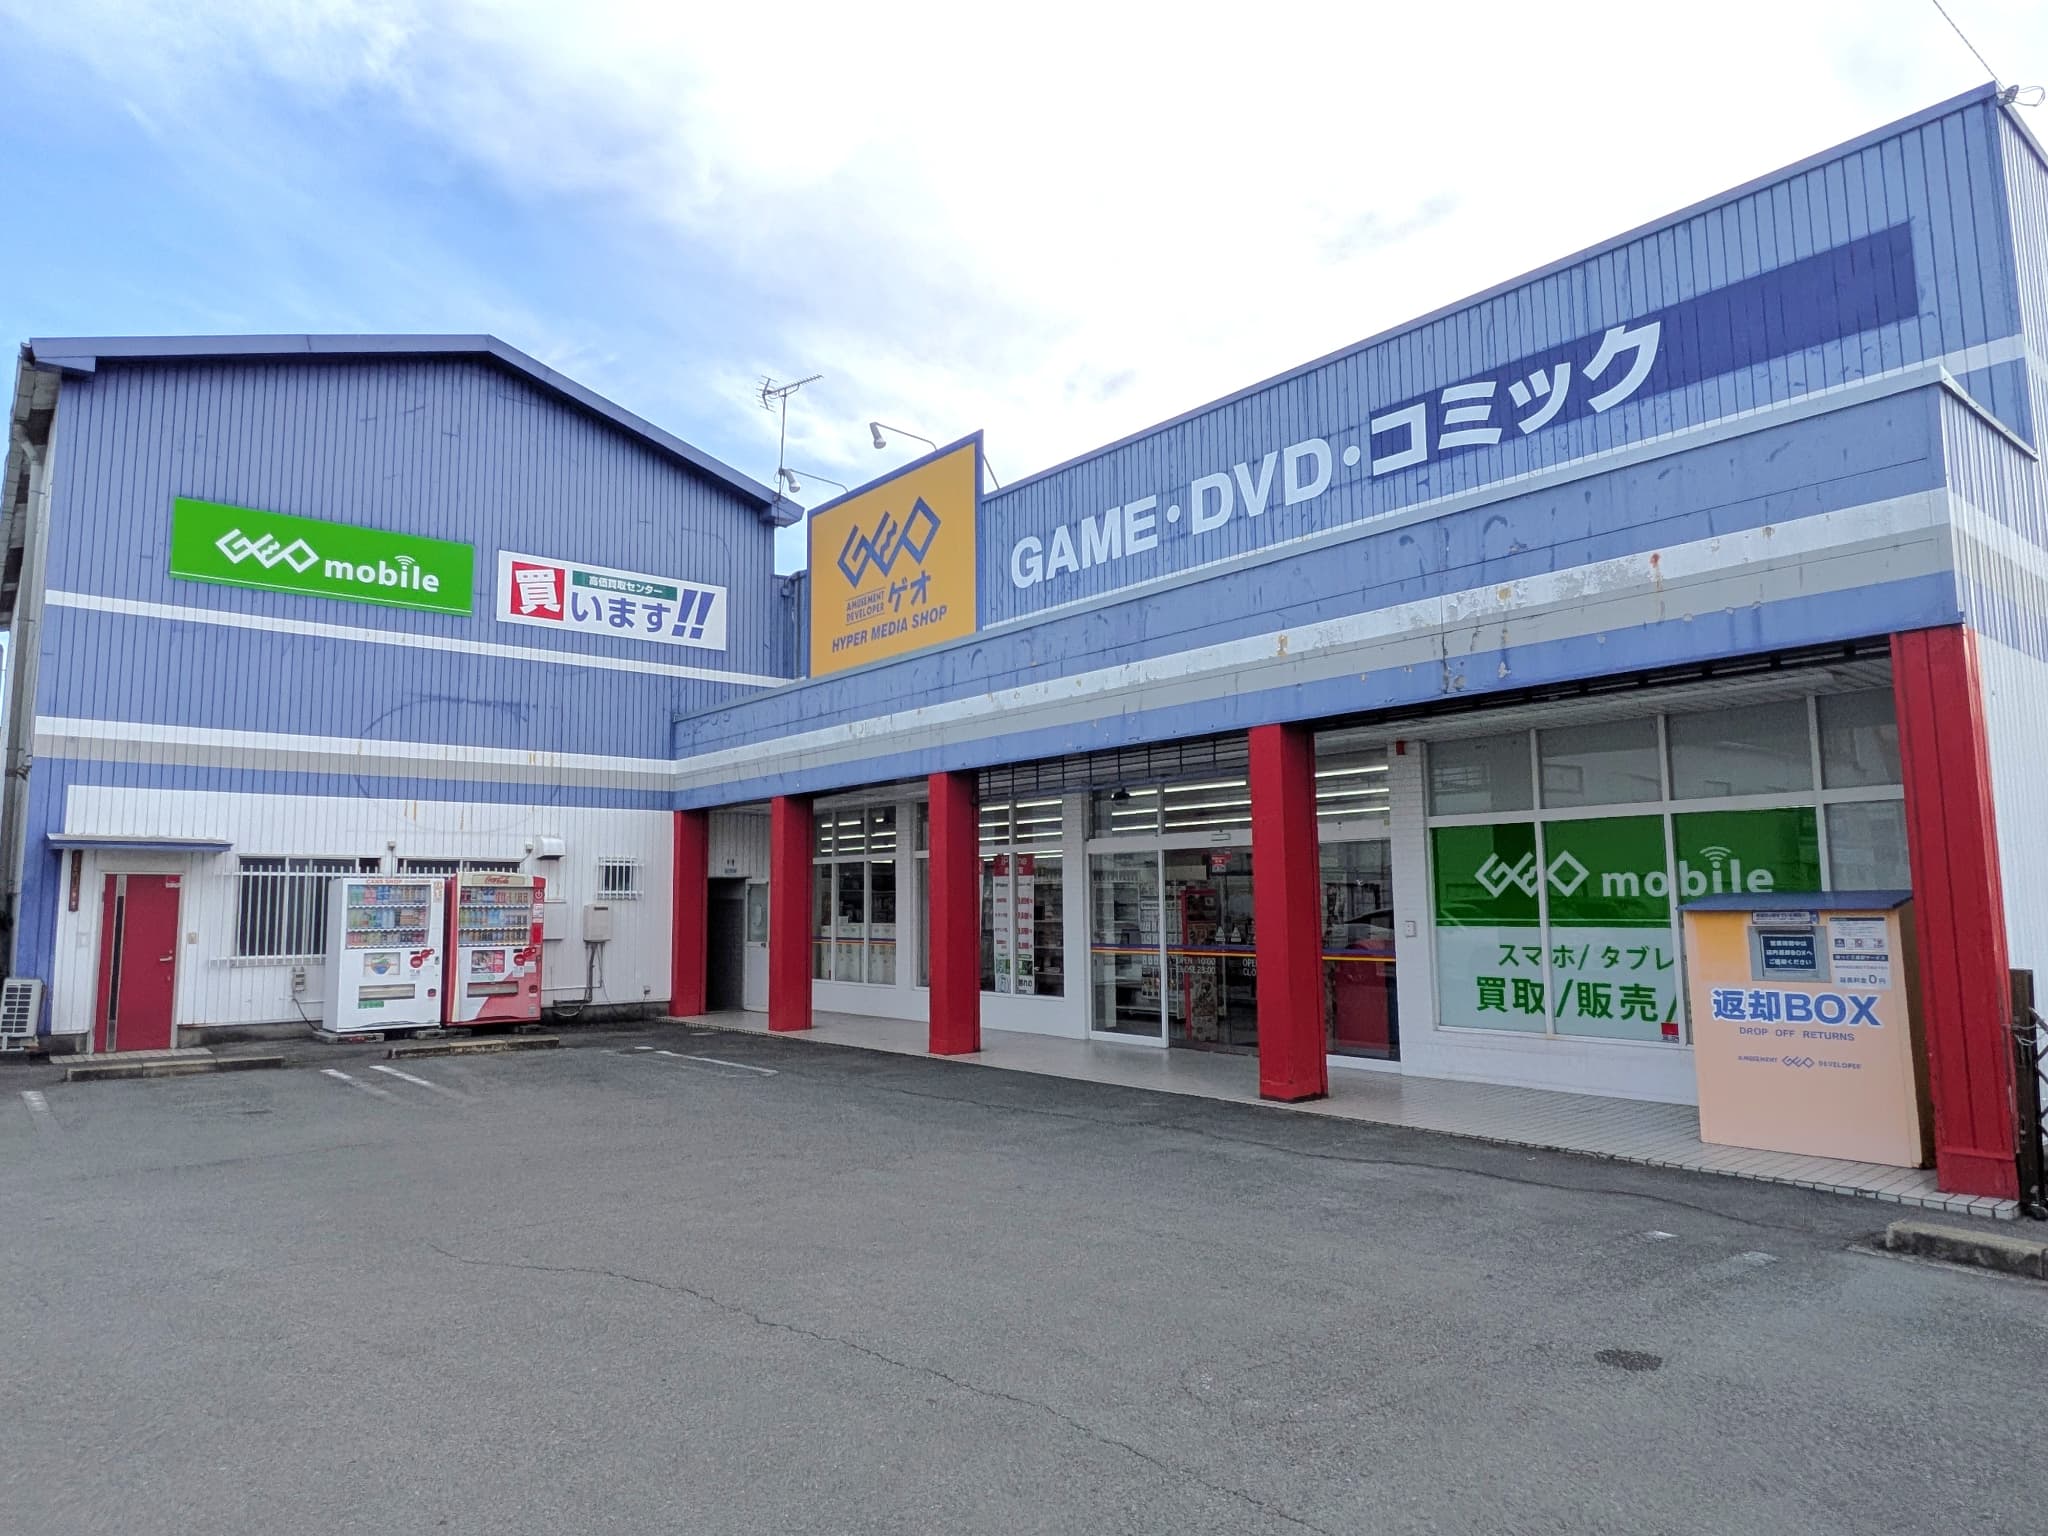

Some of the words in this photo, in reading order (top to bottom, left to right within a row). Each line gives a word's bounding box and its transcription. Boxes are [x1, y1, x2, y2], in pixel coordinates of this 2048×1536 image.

[214, 528, 319, 572] GEO
[324, 558, 440, 593] mobile
[837, 496, 941, 589] GEO
[588, 575, 664, 595] 高価買取センター
[846, 591, 885, 611] AMUSEMENT
[888, 570, 931, 613] ゲオ
[832, 630, 868, 653] HYPER
[871, 620, 908, 640] MEDIA
[912, 605, 948, 628] SHOP
[846, 602, 884, 623] DEVELOPER
[1602, 858, 1775, 897] mobile
[1712, 990, 1881, 1026] 返却BOX
[1739, 1027, 1768, 1036] DROP
[1775, 1029, 1796, 1038] OFF
[1803, 1031, 1856, 1042] RETURNS
